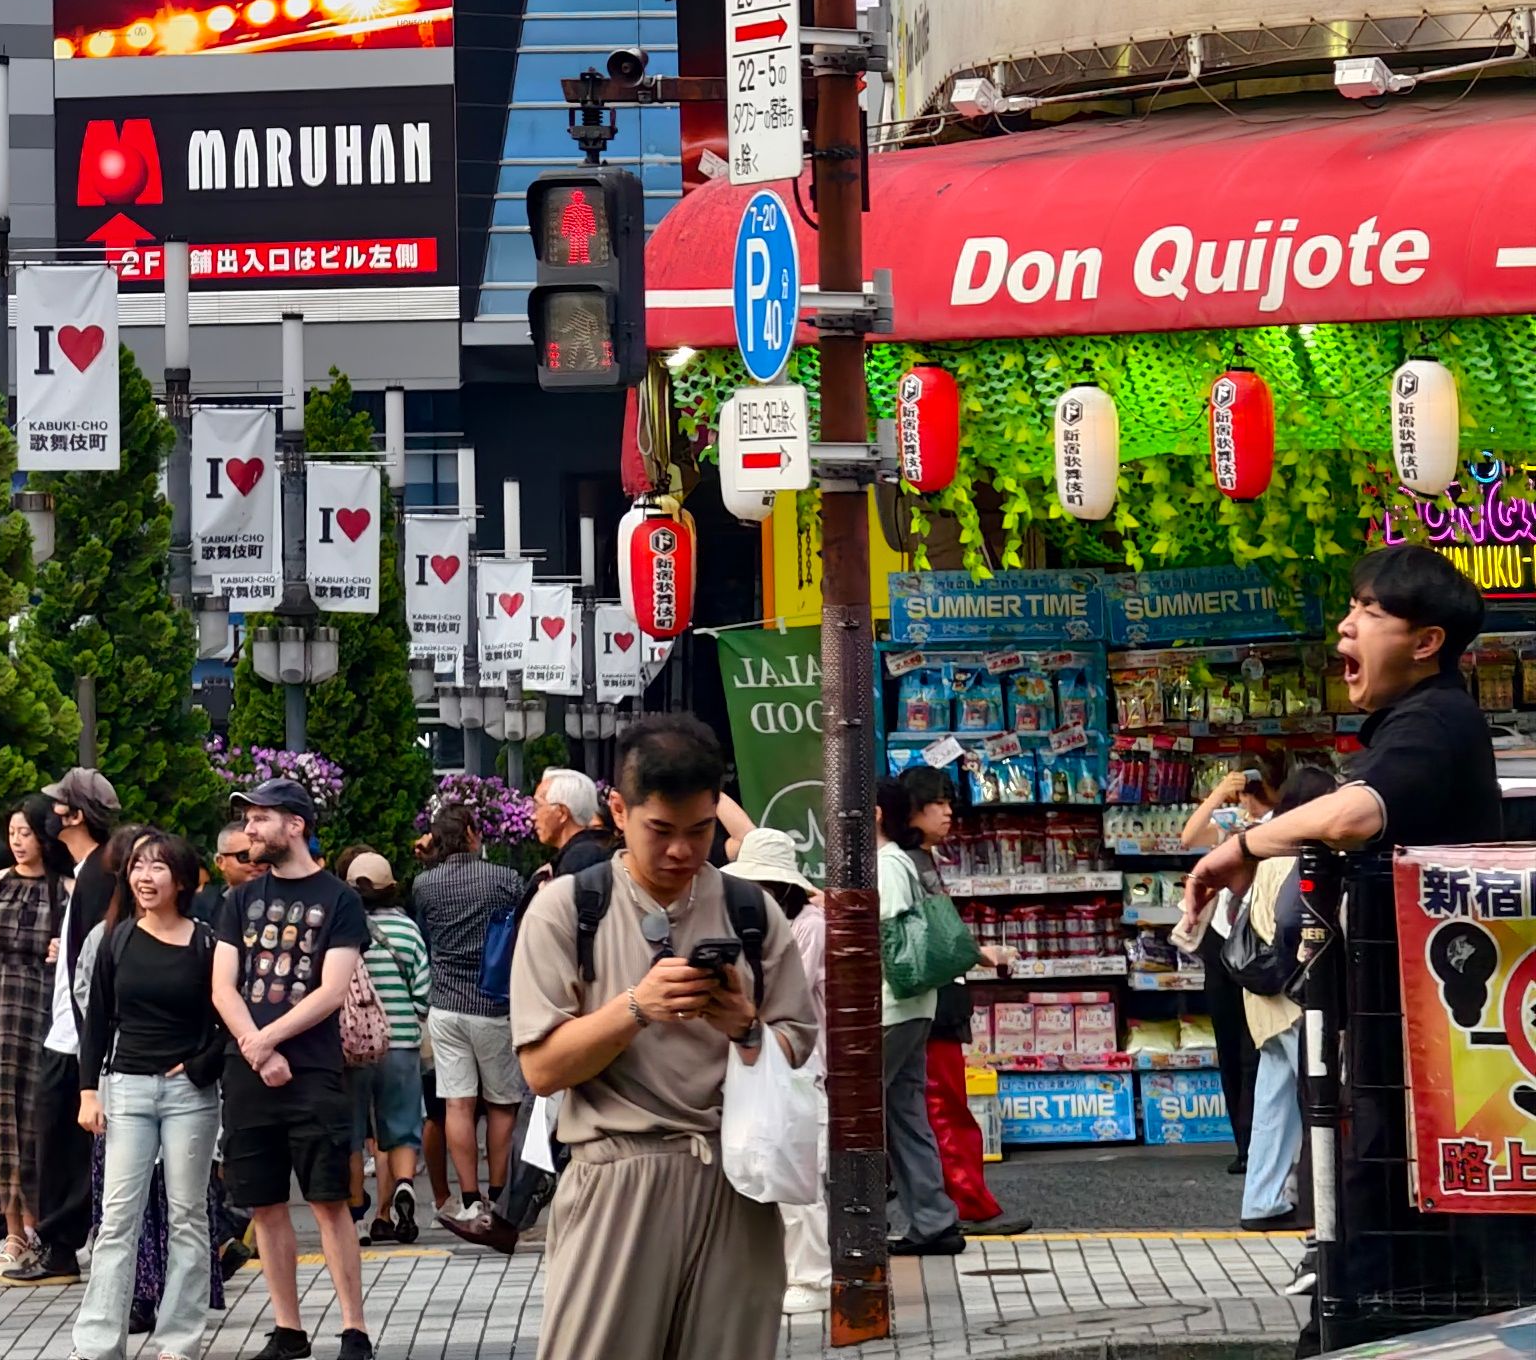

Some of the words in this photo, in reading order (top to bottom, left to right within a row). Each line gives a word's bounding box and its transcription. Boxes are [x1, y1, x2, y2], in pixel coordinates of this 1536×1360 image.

[188, 122, 432, 192] MARUHAN
[120, 245, 419, 277] 2F舗出入口はビル左側
[950, 235, 1103, 307] Don
[1133, 215, 1431, 313] Quijote
[746, 237, 771, 352] P
[763, 299, 783, 351] 40
[33, 325, 56, 375] I
[28, 419, 109, 433] KABUKI-CHO
[29, 432, 108, 455] 歌舞伎町
[201, 534, 265, 544] KABUKI-CHO
[201, 544, 264, 560] 歌舞伎町
[221, 585, 276, 599] 歌舞伎町
[314, 576, 372, 585] KABUKI-CHO
[314, 585, 371, 599] 歌舞伎町
[907, 594, 1024, 619] SUMMER
[1025, 593, 1088, 617] TIME
[1124, 592, 1239, 619] SUMMER
[413, 621, 461, 634] 歌舞伎町
[1419, 866, 1536, 920] 新宿
[998, 1096, 1051, 1120] MER
[1054, 1093, 1115, 1118] TIME
